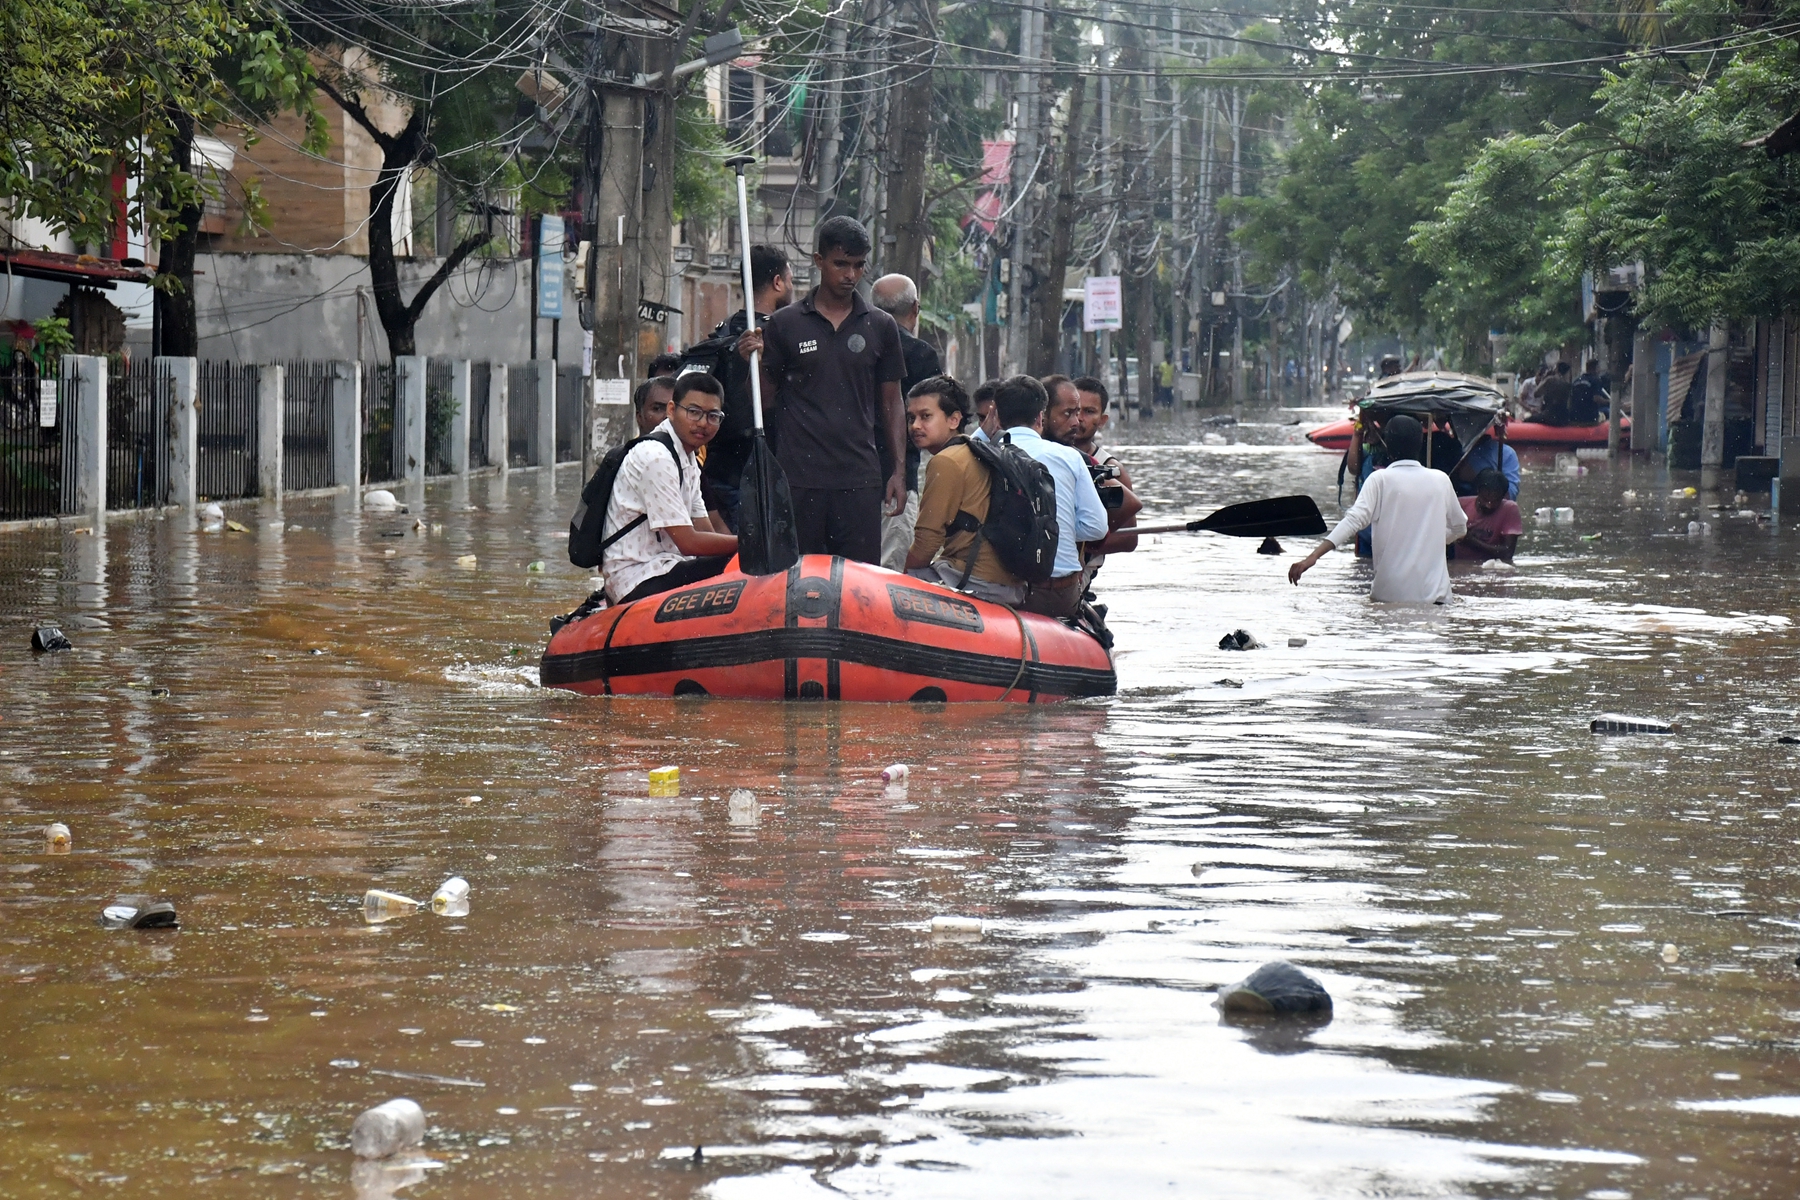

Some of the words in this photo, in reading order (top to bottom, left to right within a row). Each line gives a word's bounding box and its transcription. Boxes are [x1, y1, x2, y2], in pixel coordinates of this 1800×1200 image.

[798, 339, 818, 349] F&ES
[799, 345, 818, 355] ASSAM
[663, 593, 702, 613] GEE
[700, 587, 739, 608] PEE
[896, 591, 937, 615] GEE
[938, 600, 977, 623] PEE
